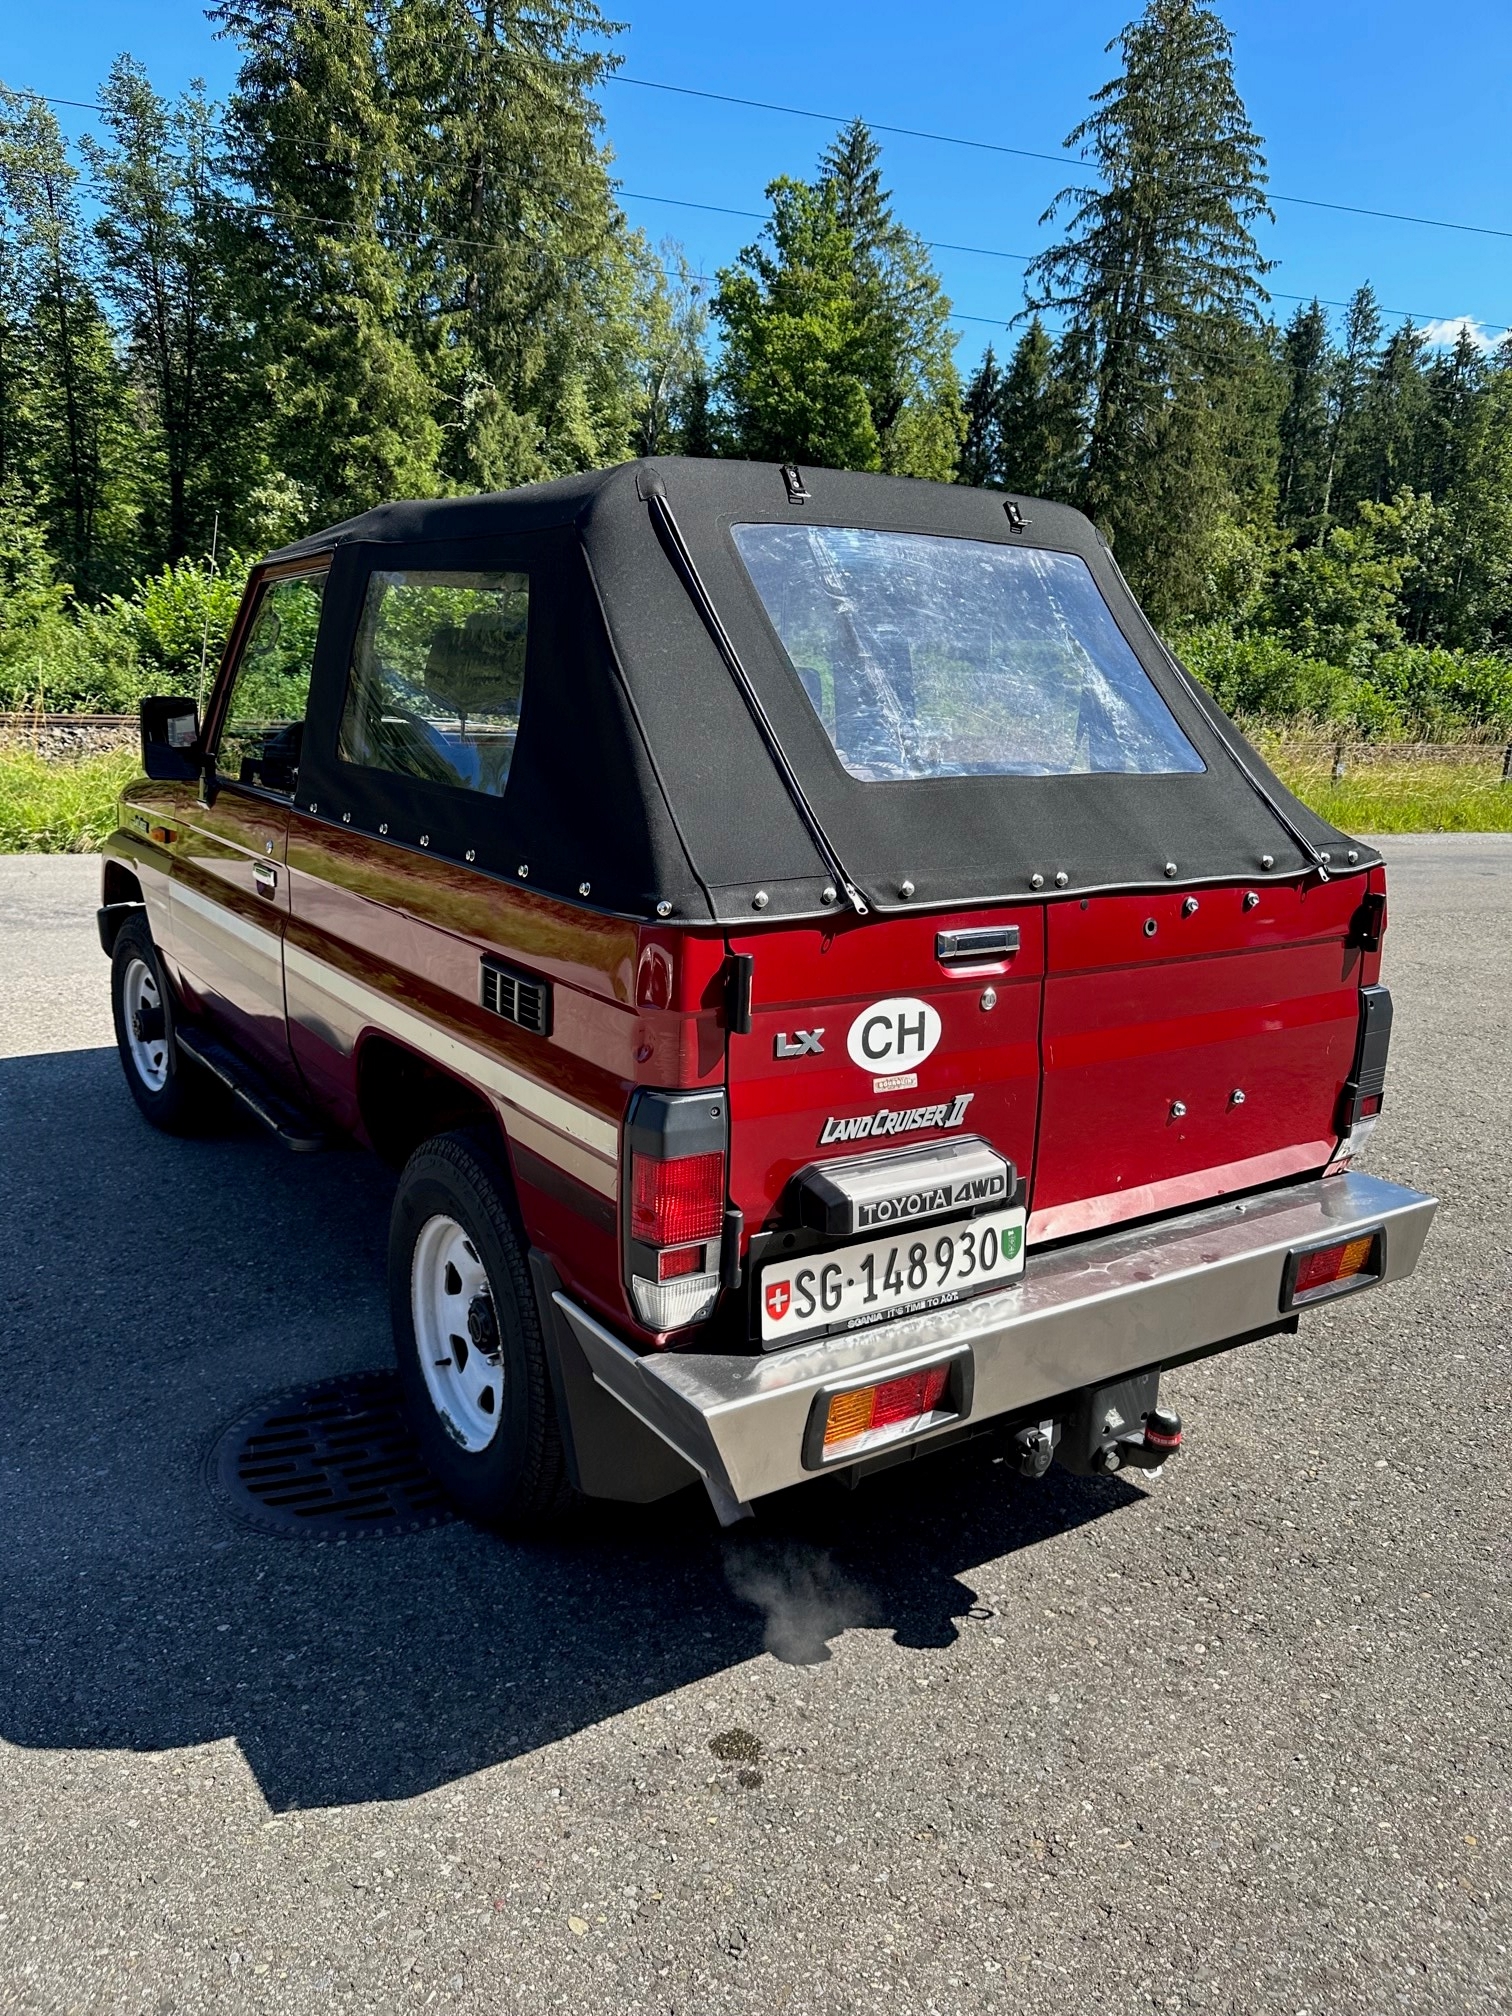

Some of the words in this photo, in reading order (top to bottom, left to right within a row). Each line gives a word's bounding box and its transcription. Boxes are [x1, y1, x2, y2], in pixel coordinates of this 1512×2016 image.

[775, 1028, 825, 1058] LX
[861, 1011, 926, 1060] CH
[863, 1189, 948, 1226] TOYOTA
[953, 1174, 1005, 1205] 4WD
[847, 1312, 883, 1329] SCANIA
[887, 1307, 904, 1319] IT'S
[905, 1301, 926, 1313] TIME
[927, 1297, 939, 1307] TO
[1147, 1431, 1178, 1446] bosal
